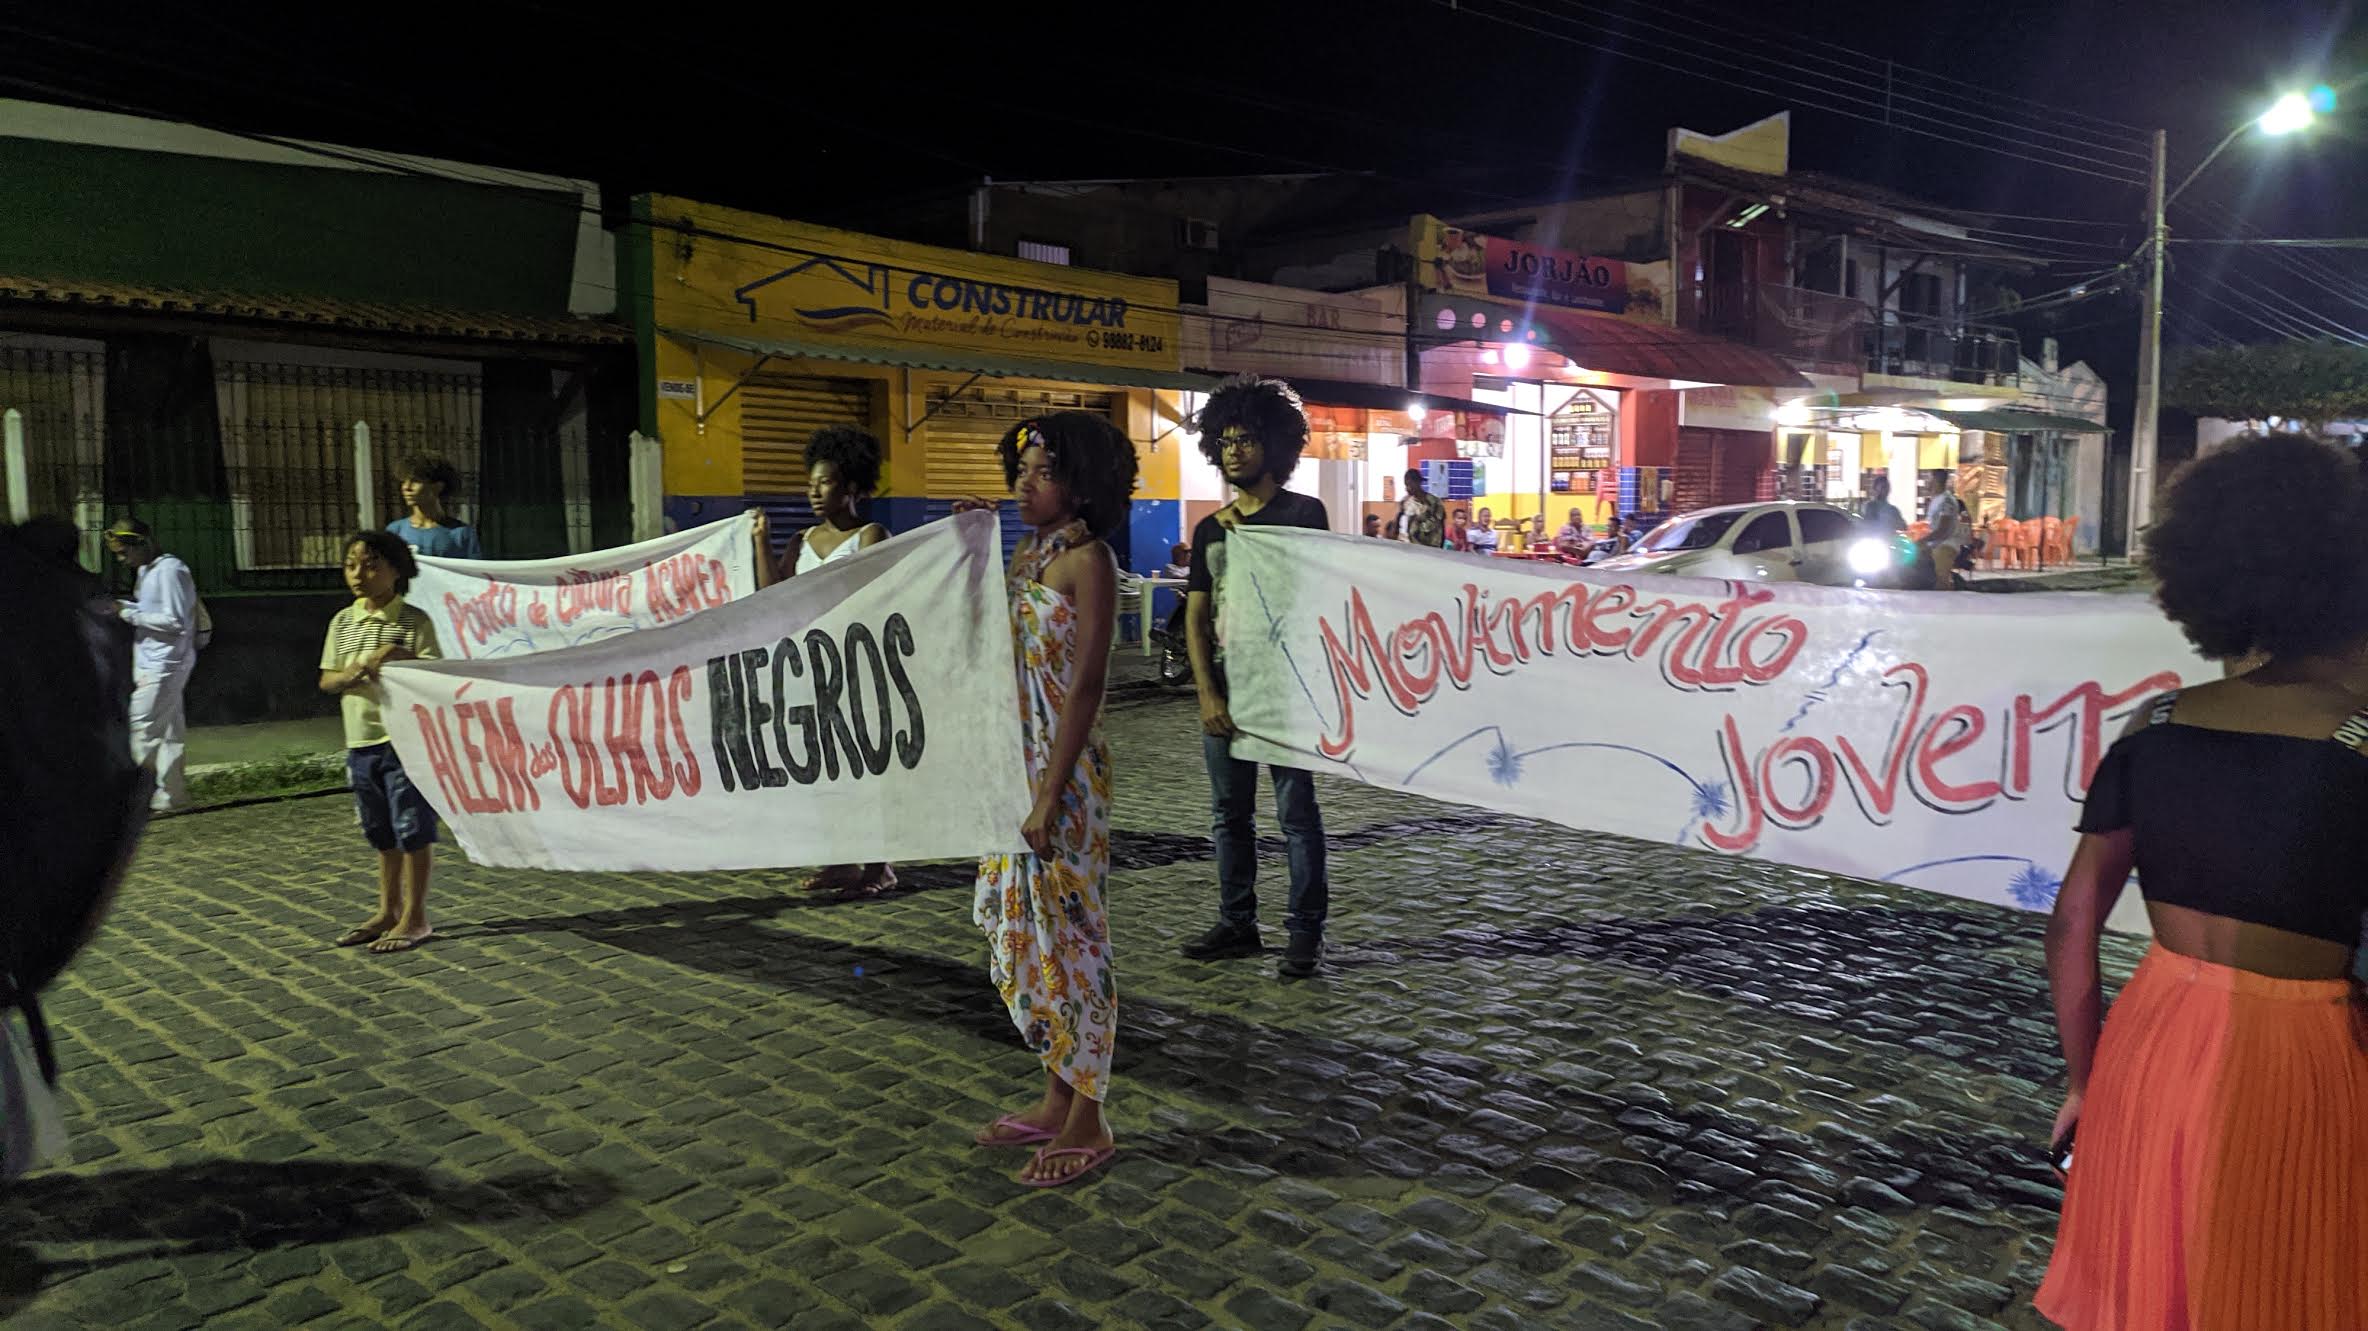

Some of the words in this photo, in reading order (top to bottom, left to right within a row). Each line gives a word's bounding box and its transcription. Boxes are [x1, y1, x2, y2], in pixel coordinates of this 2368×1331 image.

[907, 275, 1130, 329] CONSTRULAR
[1504, 250, 1611, 288] JORJÃO
[1306, 304, 1343, 331] BAR
[443, 573, 517, 660] Ponto
[527, 590, 549, 629] de
[1316, 580, 1809, 760] Movimento
[412, 681, 542, 816] ALÉM
[547, 665, 702, 811] OLHOS
[706, 612, 926, 793] NEGROS
